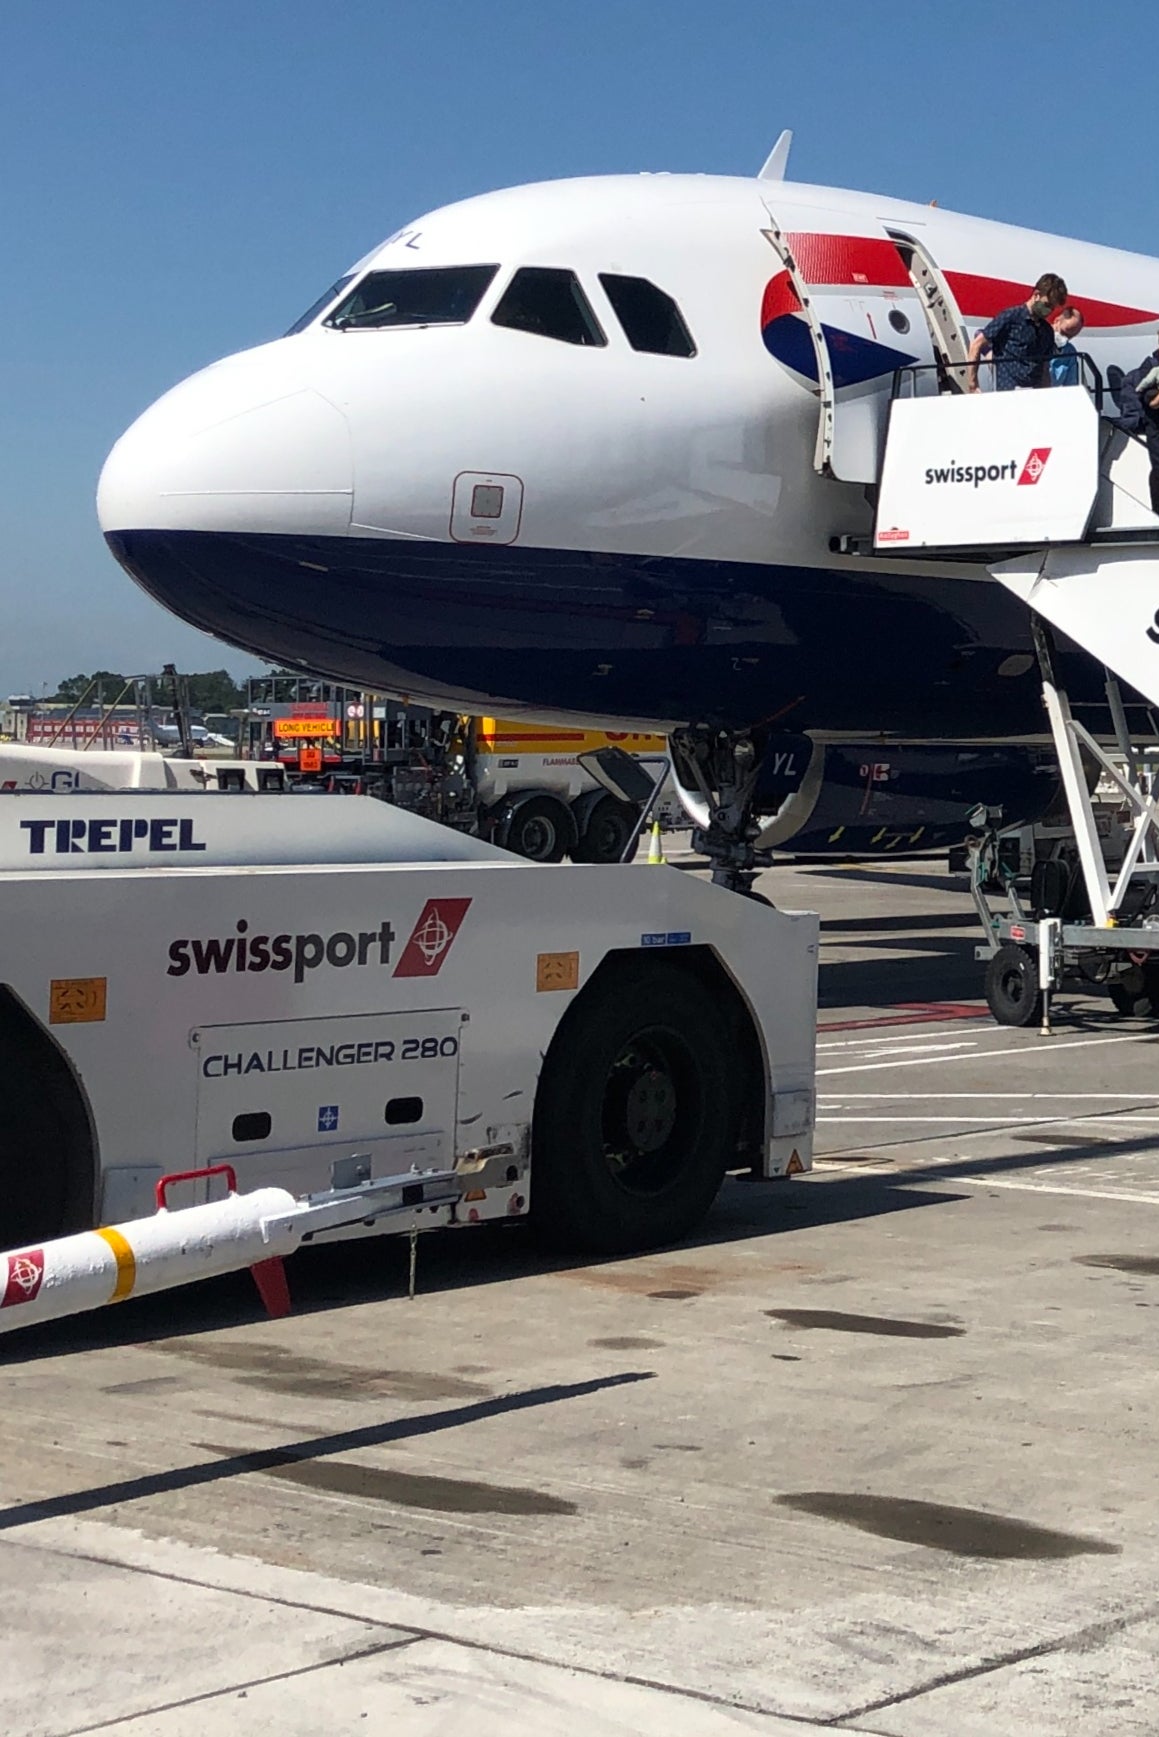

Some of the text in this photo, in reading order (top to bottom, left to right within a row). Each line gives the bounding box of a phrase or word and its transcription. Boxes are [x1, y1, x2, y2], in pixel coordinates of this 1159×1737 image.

[925, 459, 1017, 488] swissport
[278, 723, 300, 733] LONG
[773, 753, 797, 776] YL
[20, 818, 207, 854] TREPEL
[166, 919, 396, 984] swissport
[202, 1036, 458, 1078] CHALLENGER 280
